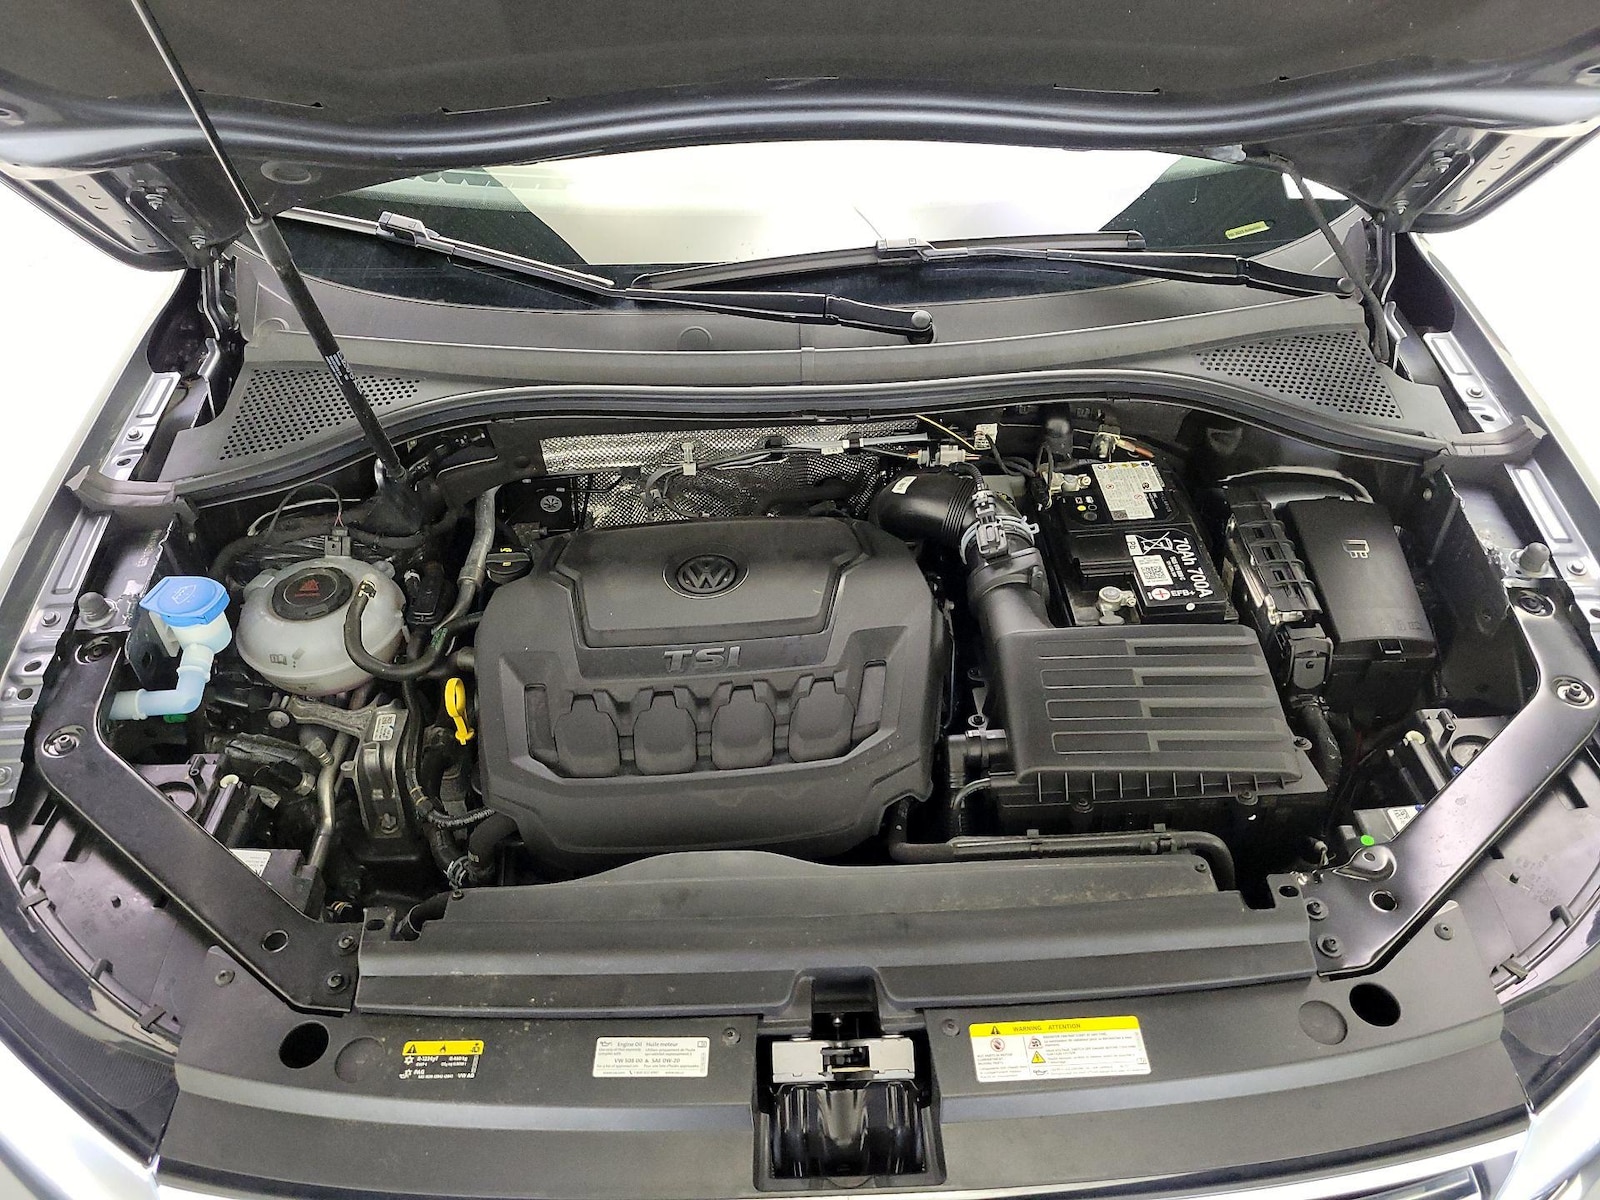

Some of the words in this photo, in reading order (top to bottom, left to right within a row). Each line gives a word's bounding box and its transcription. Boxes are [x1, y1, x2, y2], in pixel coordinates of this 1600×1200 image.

[1172, 537, 1198, 566] 70Ah
[1186, 566, 1214, 598] 700A
[1170, 589, 1196, 597] EFB+
[663, 646, 742, 673] TSI
[1048, 1021, 1081, 1031] ATTENTION
